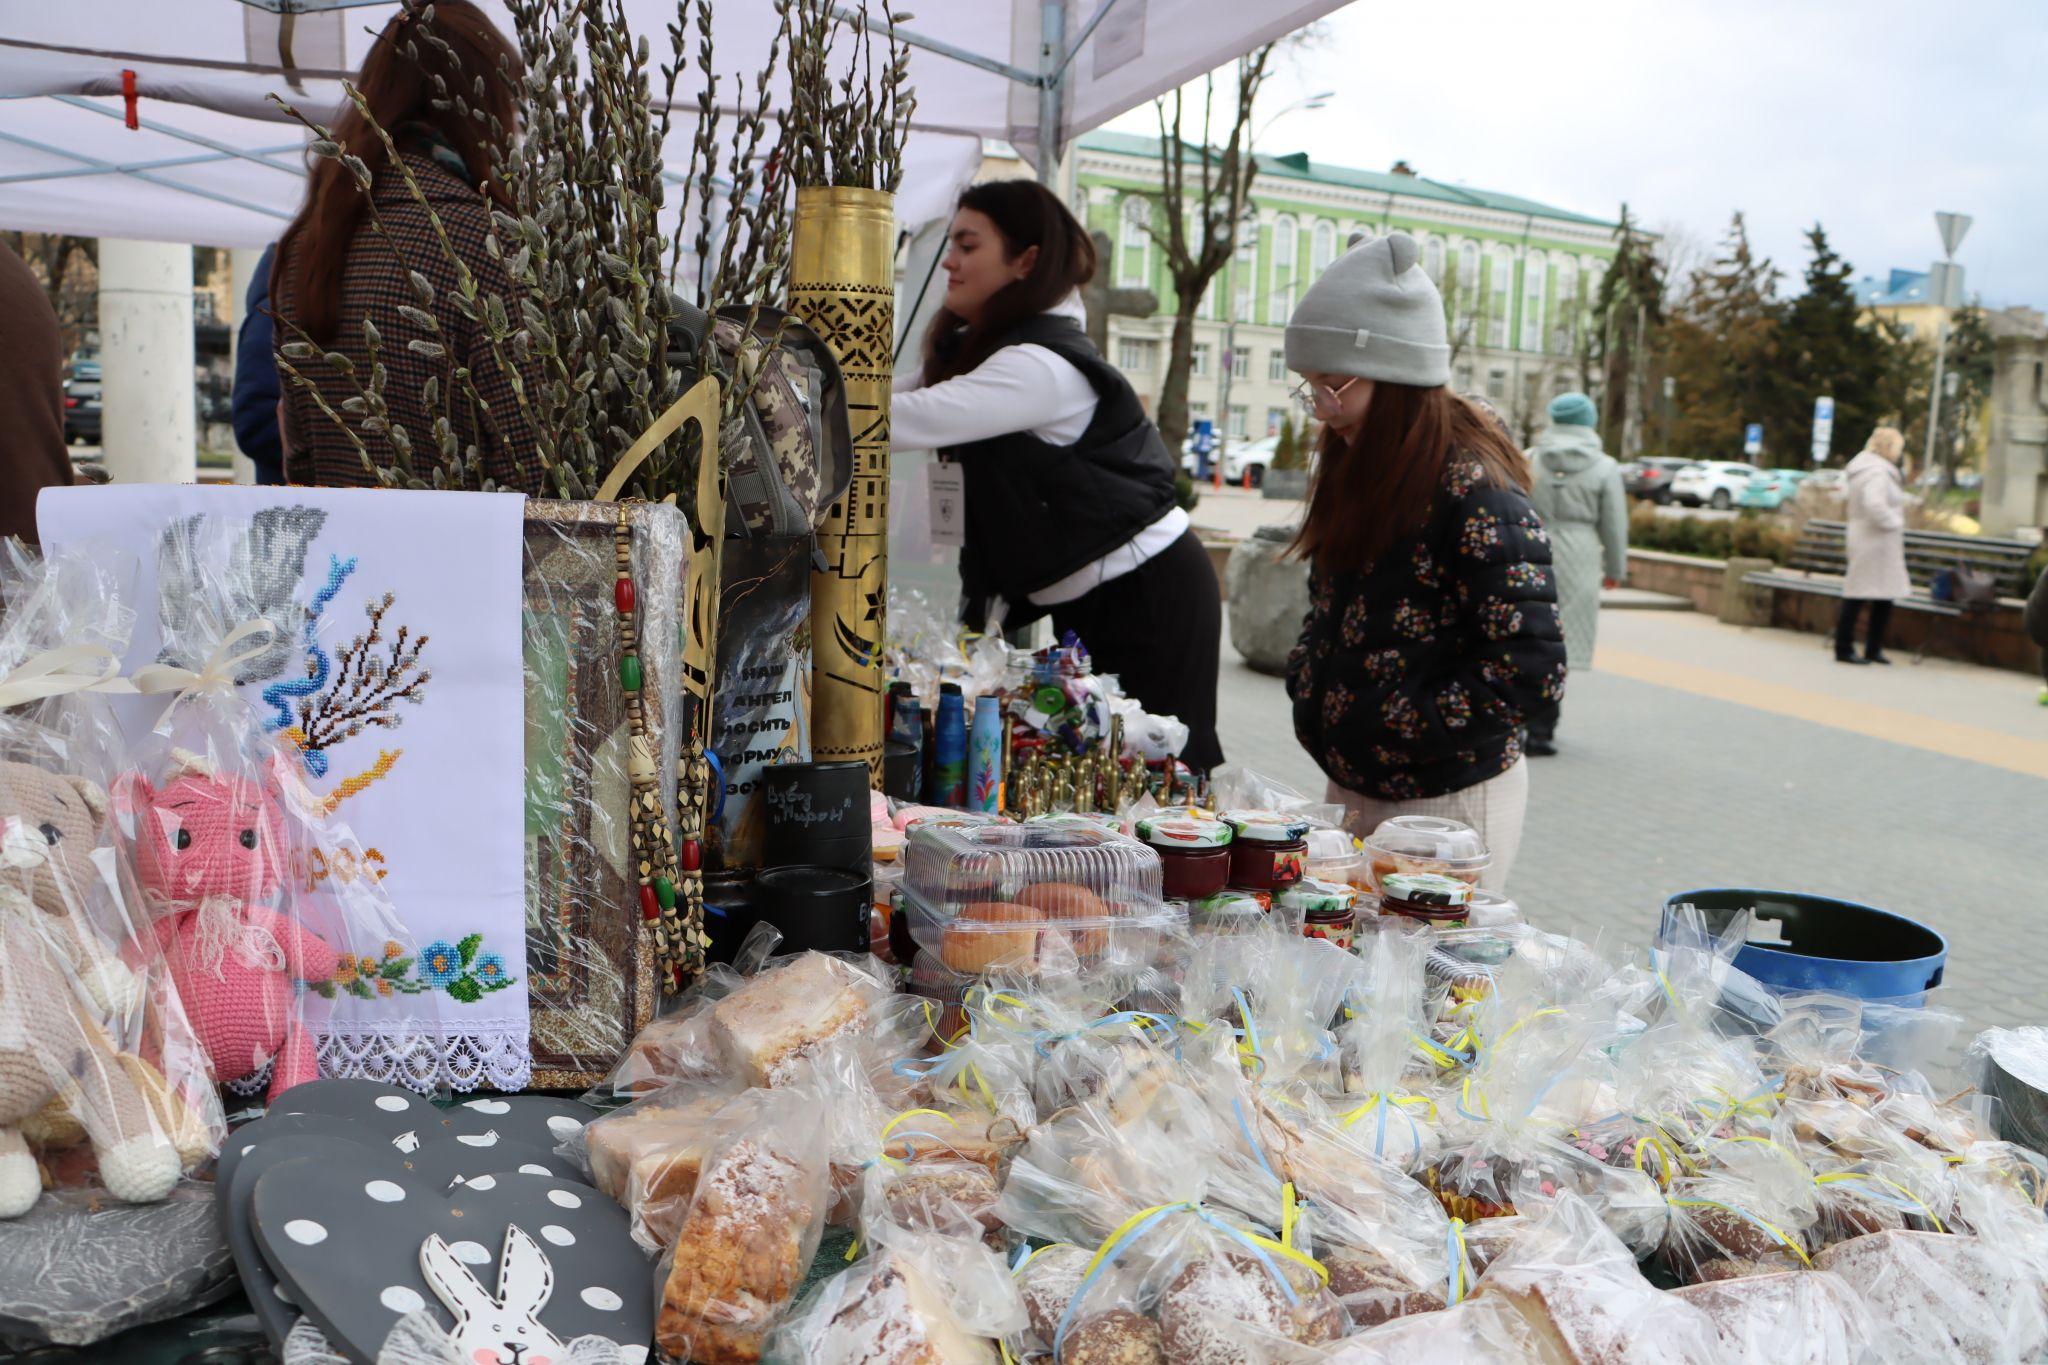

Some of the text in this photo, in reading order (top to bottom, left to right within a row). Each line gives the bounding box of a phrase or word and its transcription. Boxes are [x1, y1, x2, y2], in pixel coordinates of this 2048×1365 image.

[741, 665, 784, 681] НАШ
[732, 691, 792, 707] АНГЕЛ
[719, 718, 791, 736] НОСИТЬ
